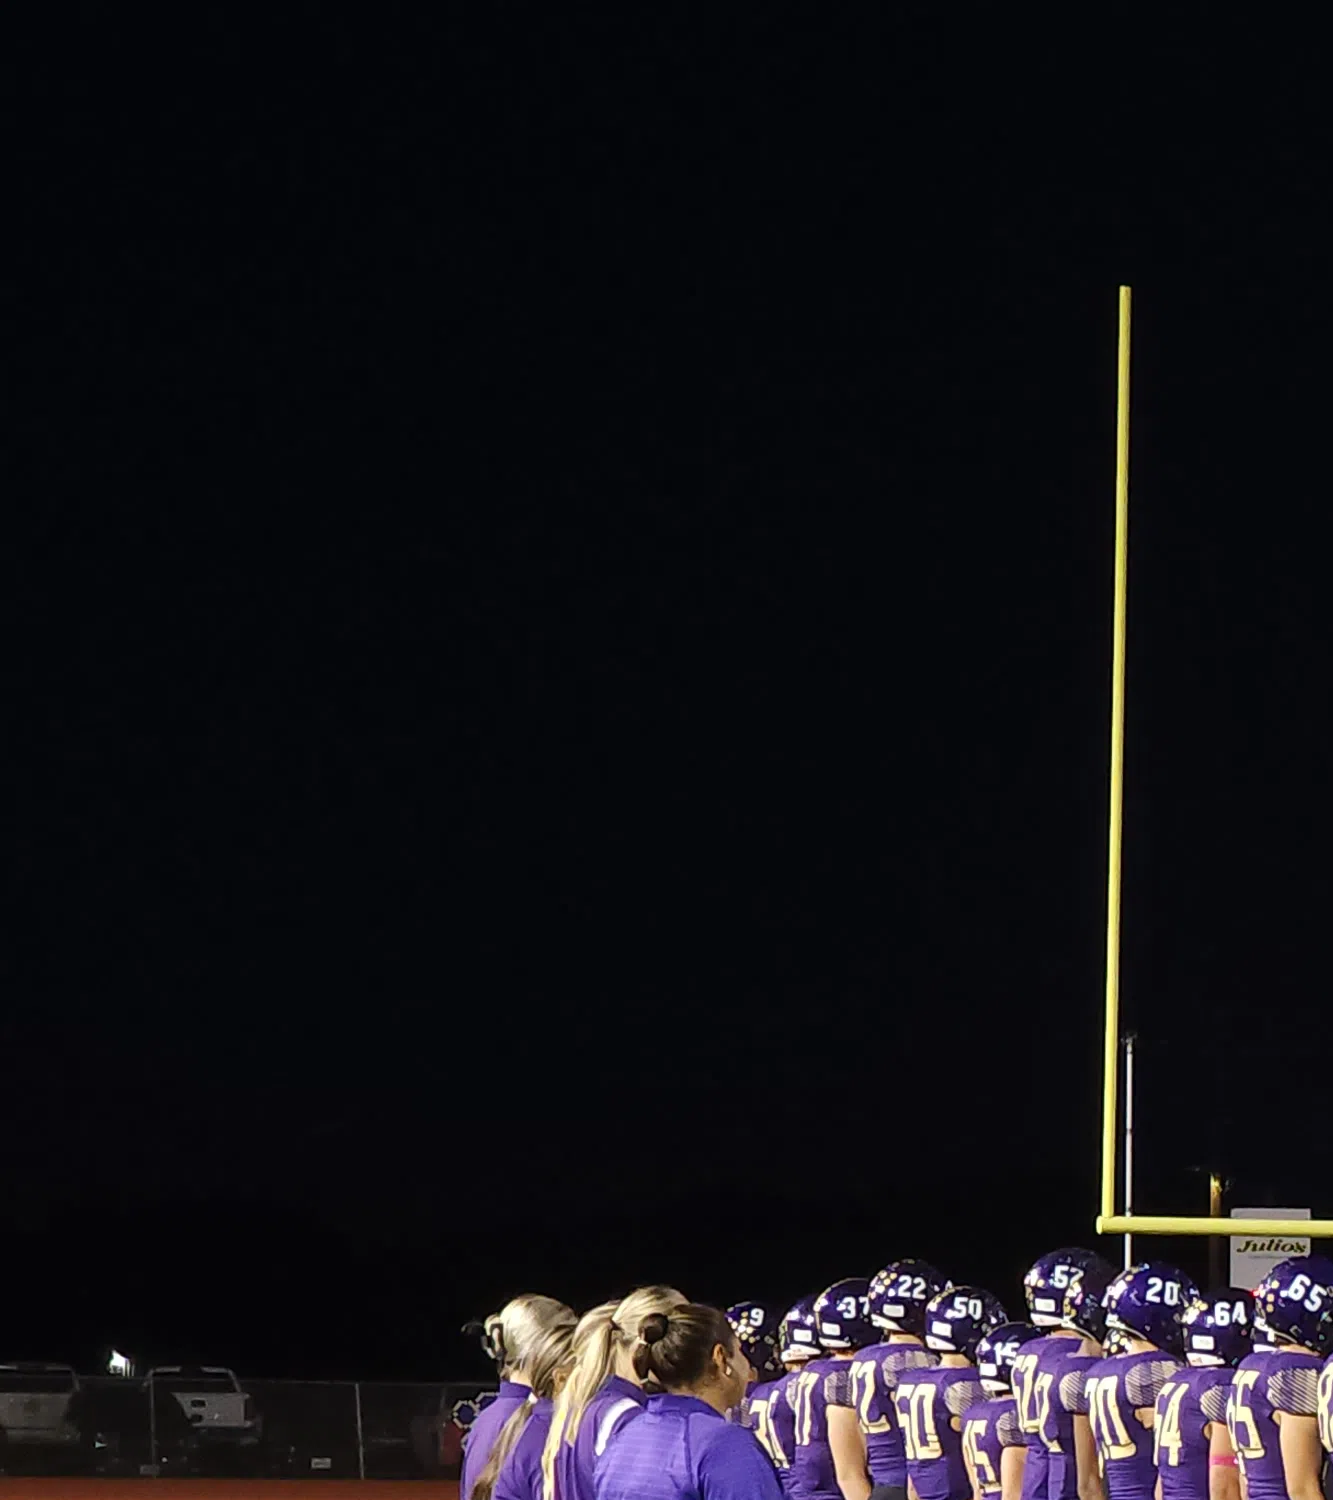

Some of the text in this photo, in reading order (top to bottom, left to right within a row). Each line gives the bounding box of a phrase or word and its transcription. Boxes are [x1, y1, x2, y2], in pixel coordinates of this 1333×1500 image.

[897, 1274, 927, 1300] 22
[1145, 1277, 1180, 1306] 20
[1288, 1274, 1328, 1312] 65
[953, 1296, 983, 1321] 50
